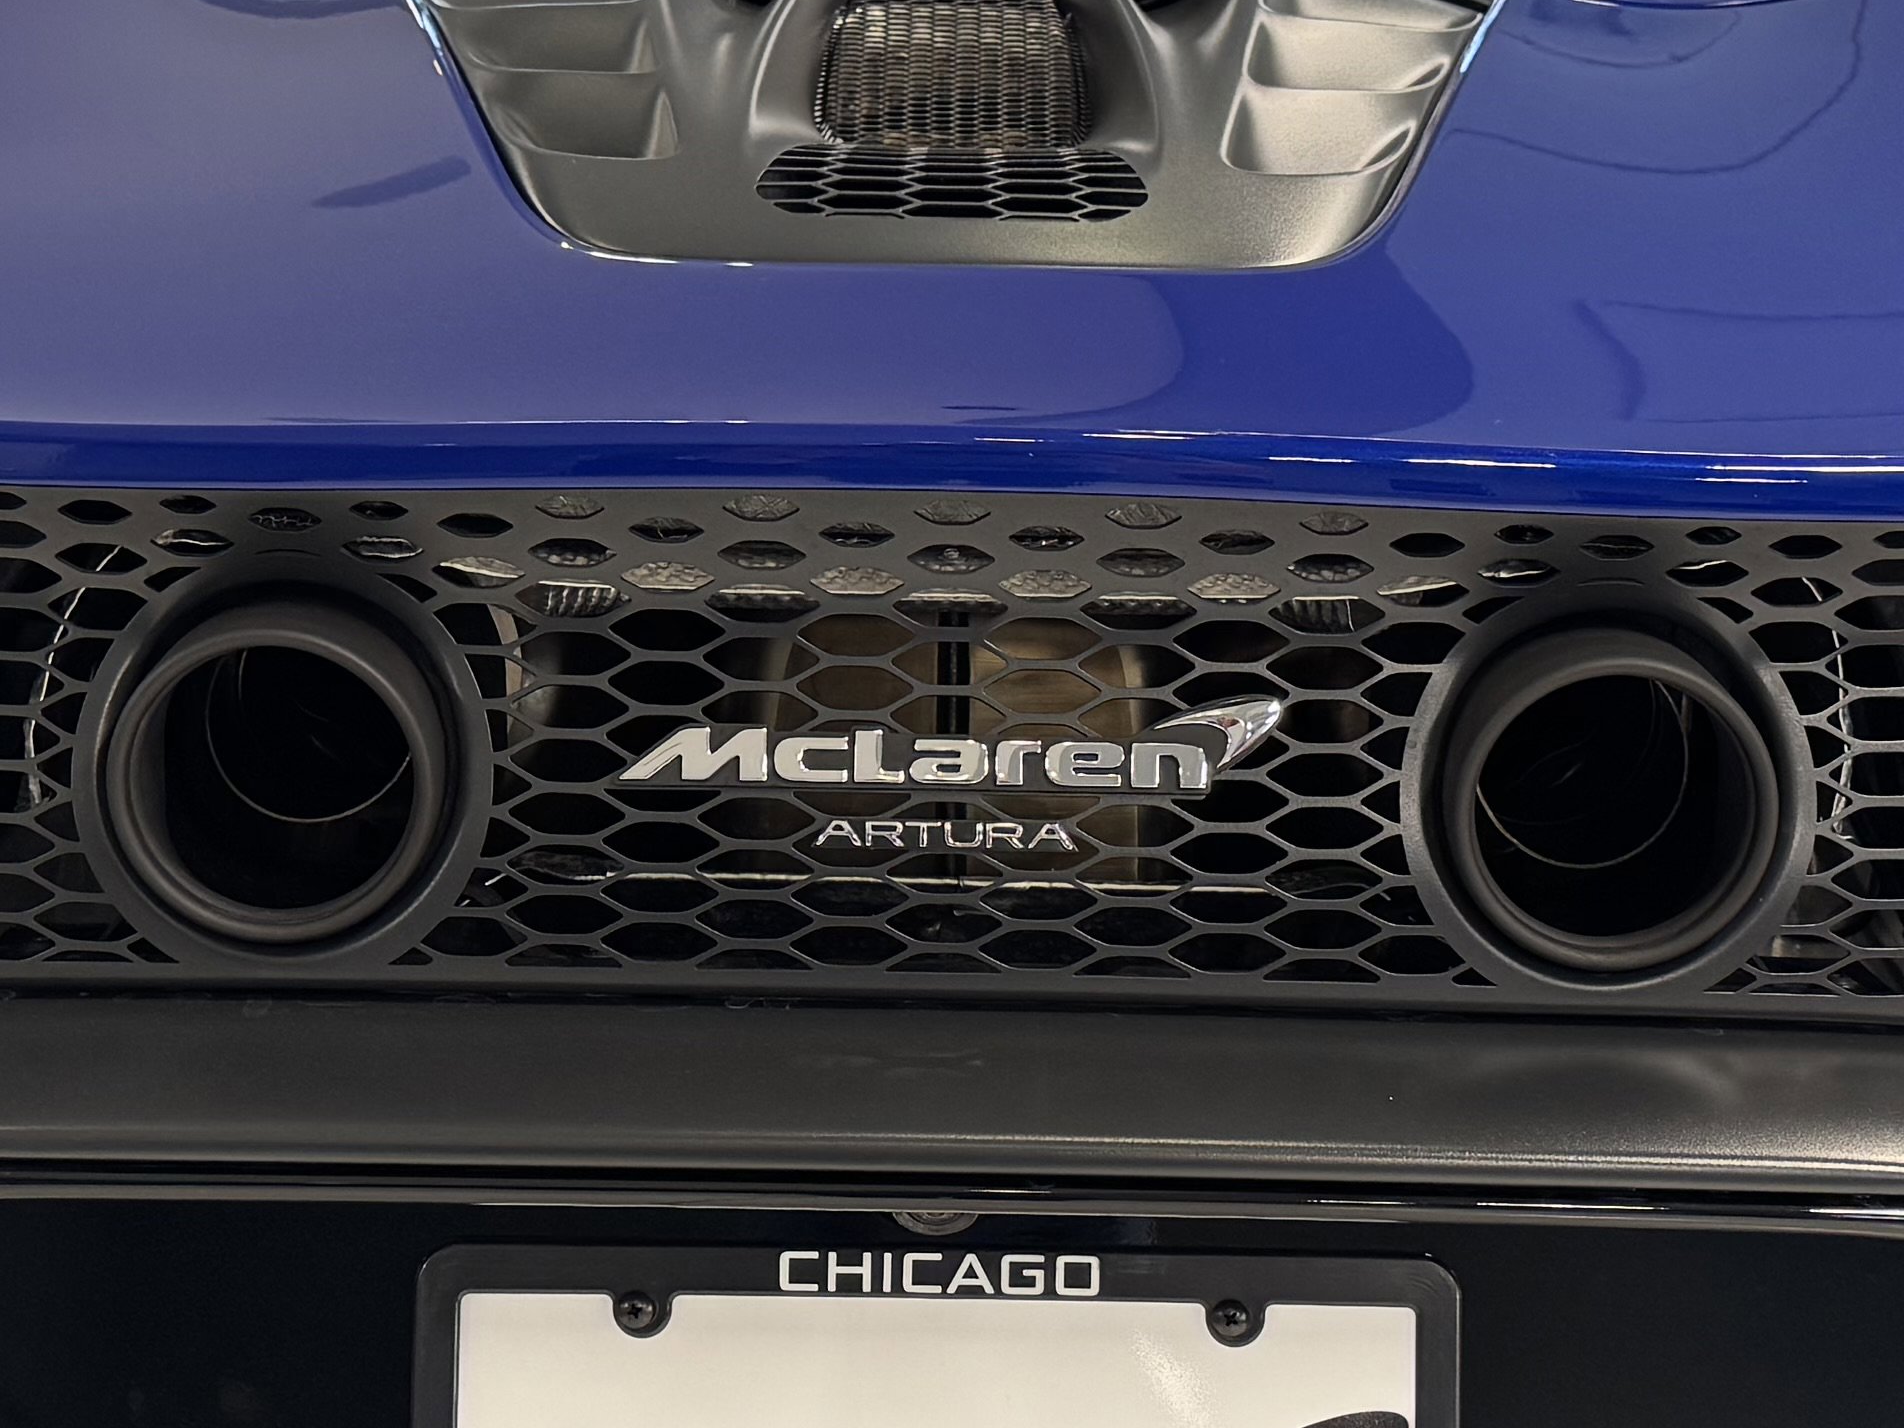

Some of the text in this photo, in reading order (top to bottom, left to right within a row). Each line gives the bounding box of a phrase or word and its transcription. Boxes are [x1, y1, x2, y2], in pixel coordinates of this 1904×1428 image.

[618, 724, 1209, 790] McLaren
[813, 819, 1079, 852] ARTURA
[778, 1250, 1101, 1298] CHICAGO
